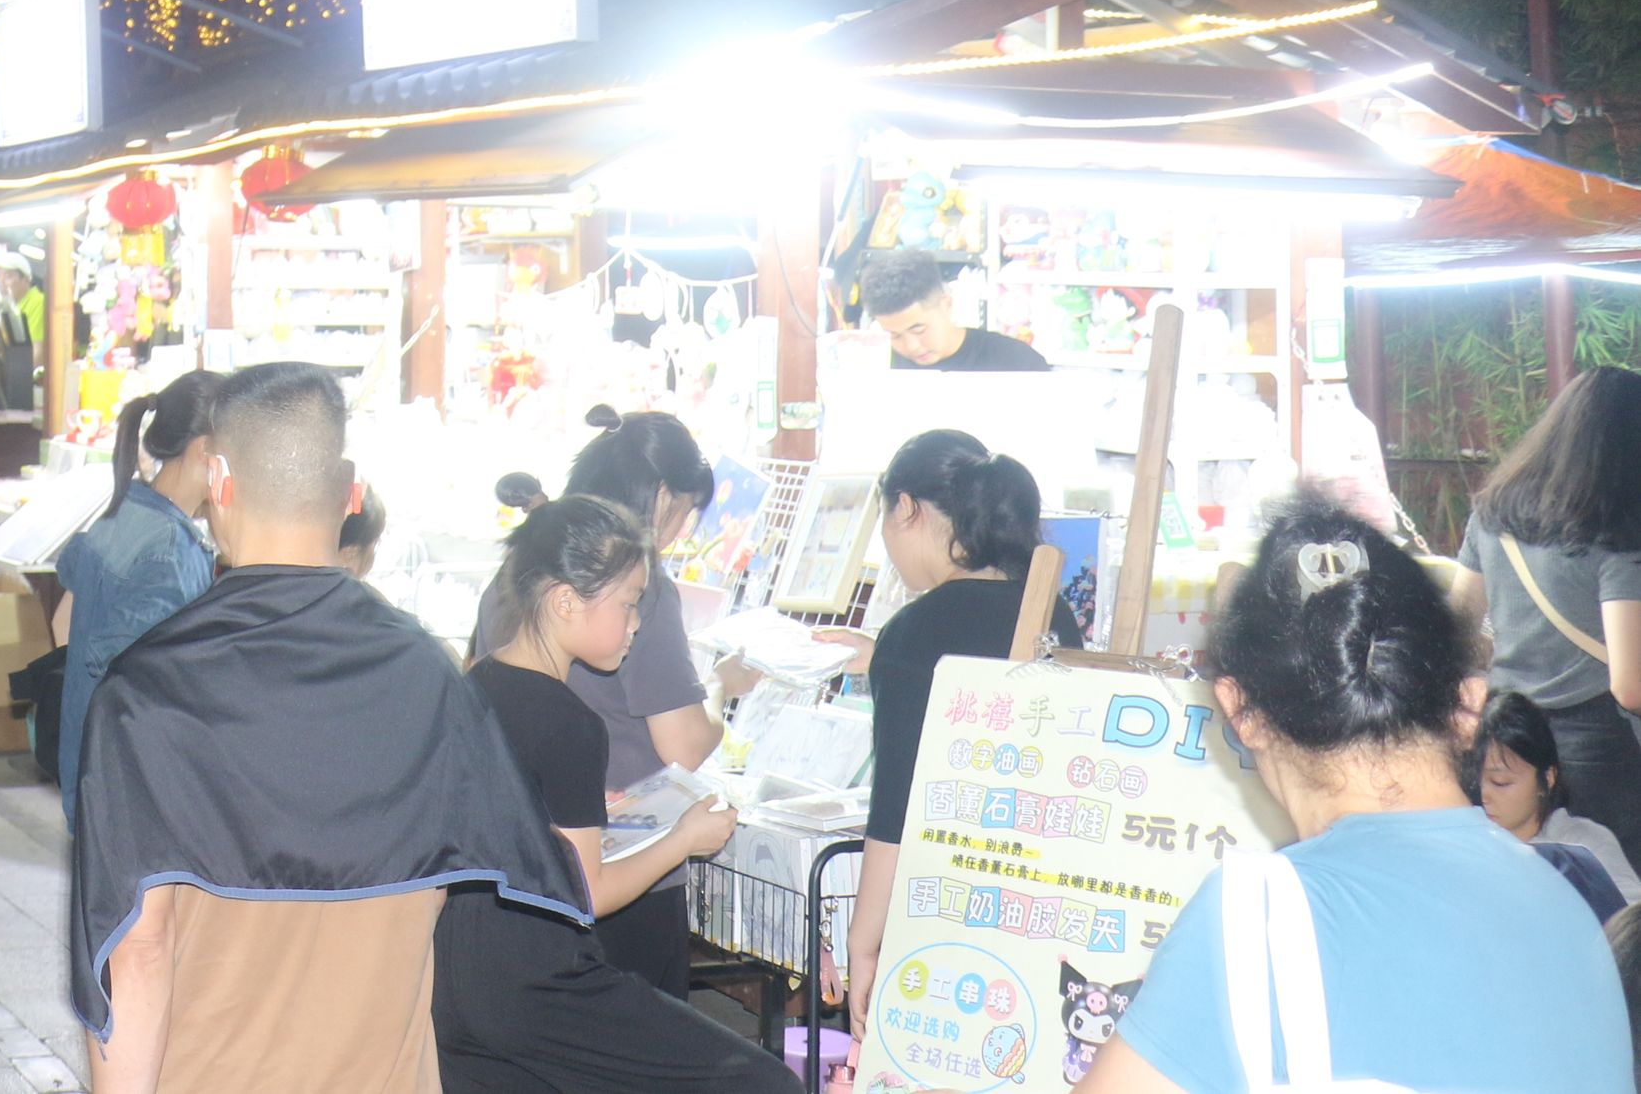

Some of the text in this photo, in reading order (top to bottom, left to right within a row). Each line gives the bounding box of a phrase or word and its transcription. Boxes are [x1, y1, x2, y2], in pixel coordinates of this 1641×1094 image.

[949, 742, 1040, 776] 数字油画
[1069, 759, 1145, 795] 钻石画
[928, 783, 1237, 860] 香薰石膏娃娃 5元1个
[911, 880, 1121, 951] 手工奶油胶发夹
[902, 967, 1011, 1015] 手工串珠
[886, 1007, 960, 1042] 欢迎选购
[906, 1042, 982, 1079] 全场任选
